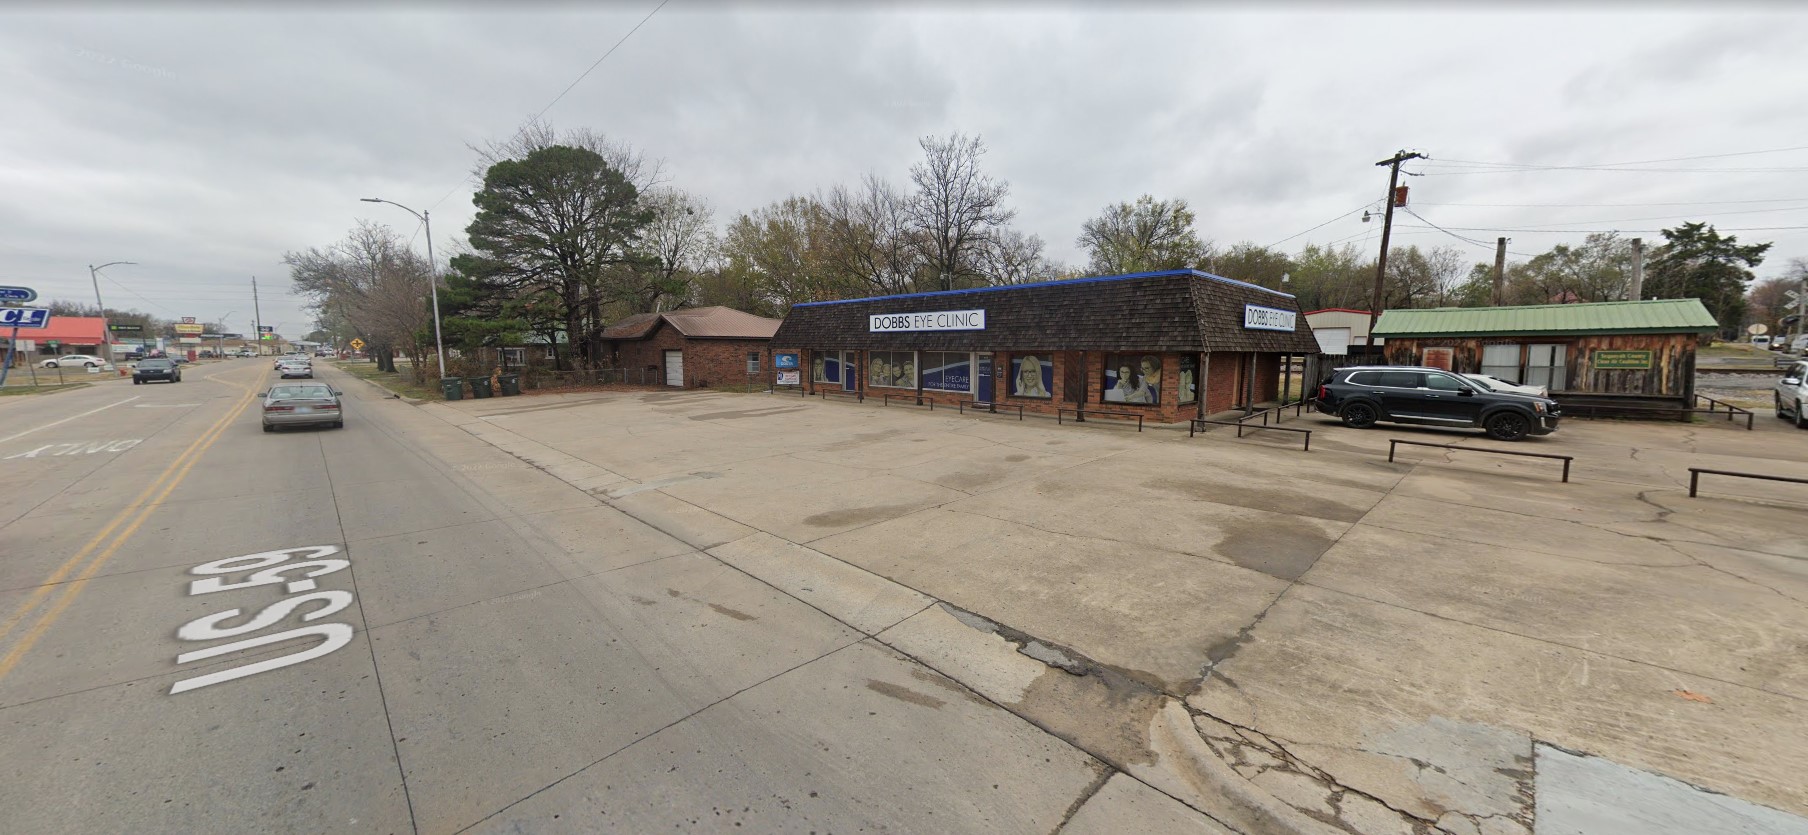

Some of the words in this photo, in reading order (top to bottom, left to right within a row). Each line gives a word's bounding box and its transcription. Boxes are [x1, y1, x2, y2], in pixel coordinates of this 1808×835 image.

[874, 315, 911, 330] DOBBS
[914, 314, 933, 328] EYE
[936, 312, 979, 328] CLINIC
[1248, 308, 1268, 326] DOBBS
[1269, 311, 1279, 327] EYE
[1279, 313, 1294, 329] CLINIC
[945, 375, 969, 384] EYECARE
[2, 439, 143, 460] ONLY
